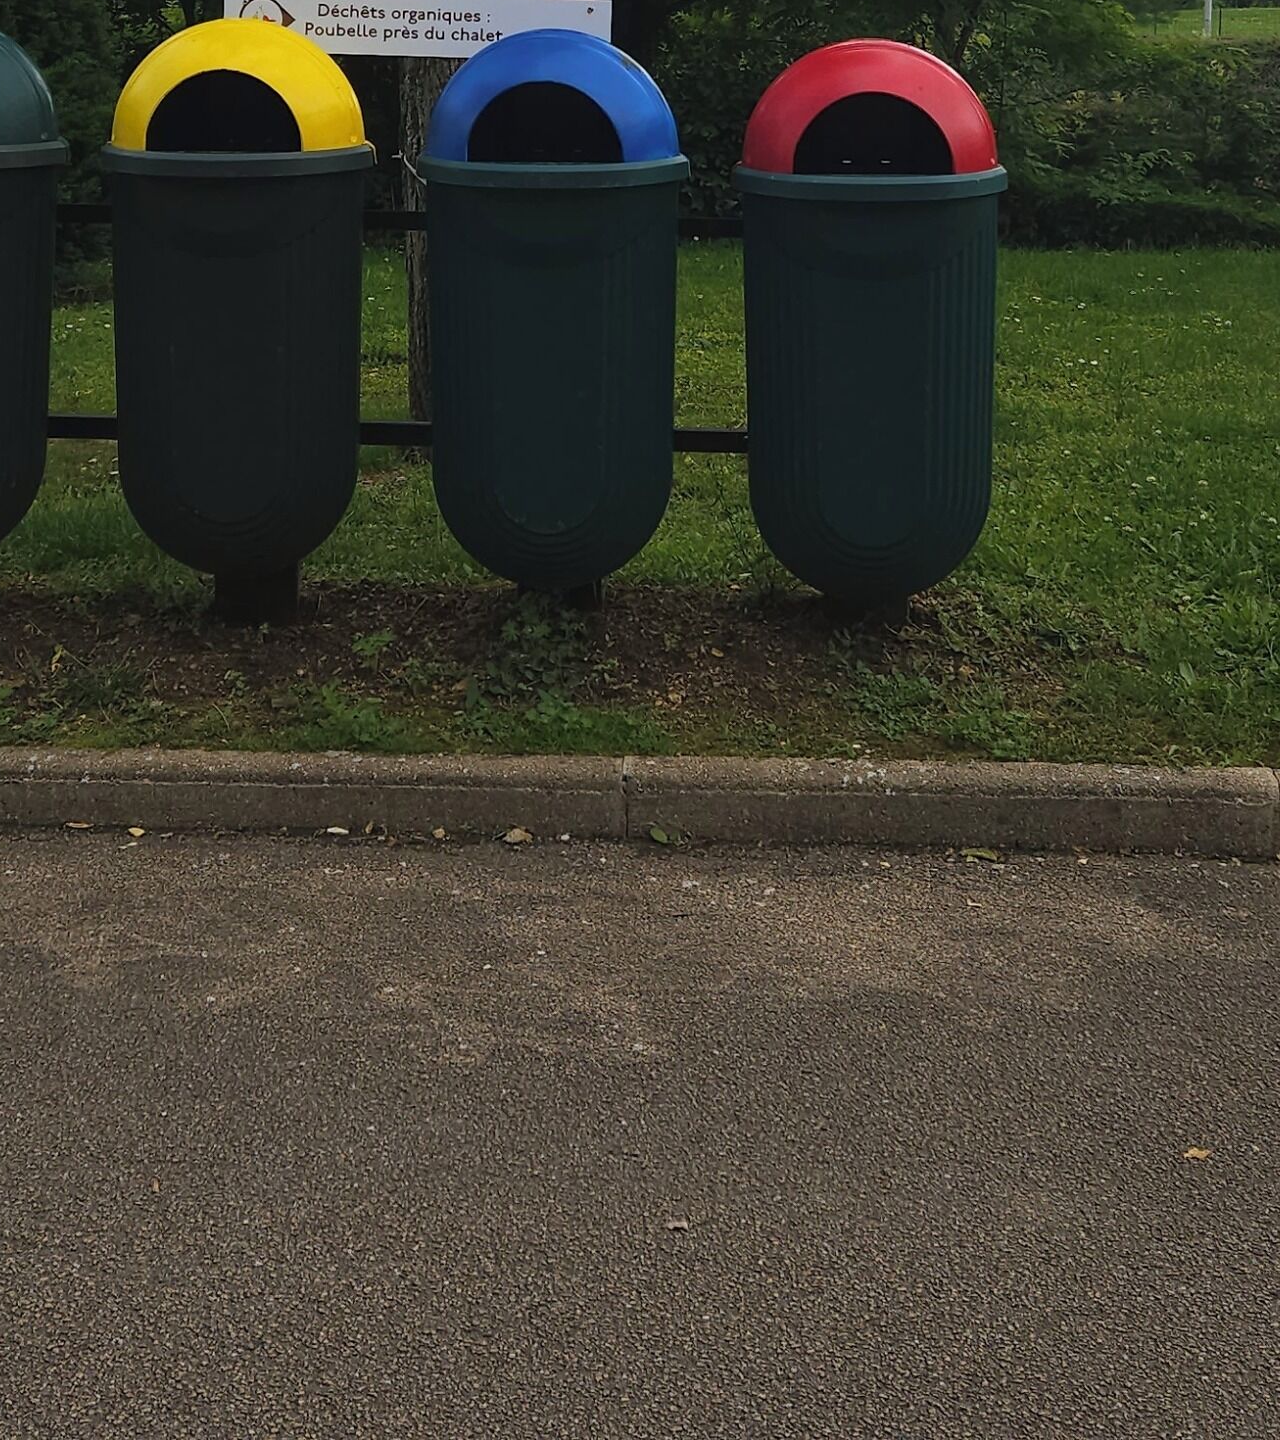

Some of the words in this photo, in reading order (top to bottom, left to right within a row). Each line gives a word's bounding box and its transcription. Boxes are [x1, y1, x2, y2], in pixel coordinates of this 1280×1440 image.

[317, 3, 386, 19] Déchêts
[391, 8, 481, 25] organiques
[305, 22, 378, 38] Poubelle
[383, 26, 419, 41] près
[424, 26, 446, 40] du
[451, 28, 503, 42] chalet
